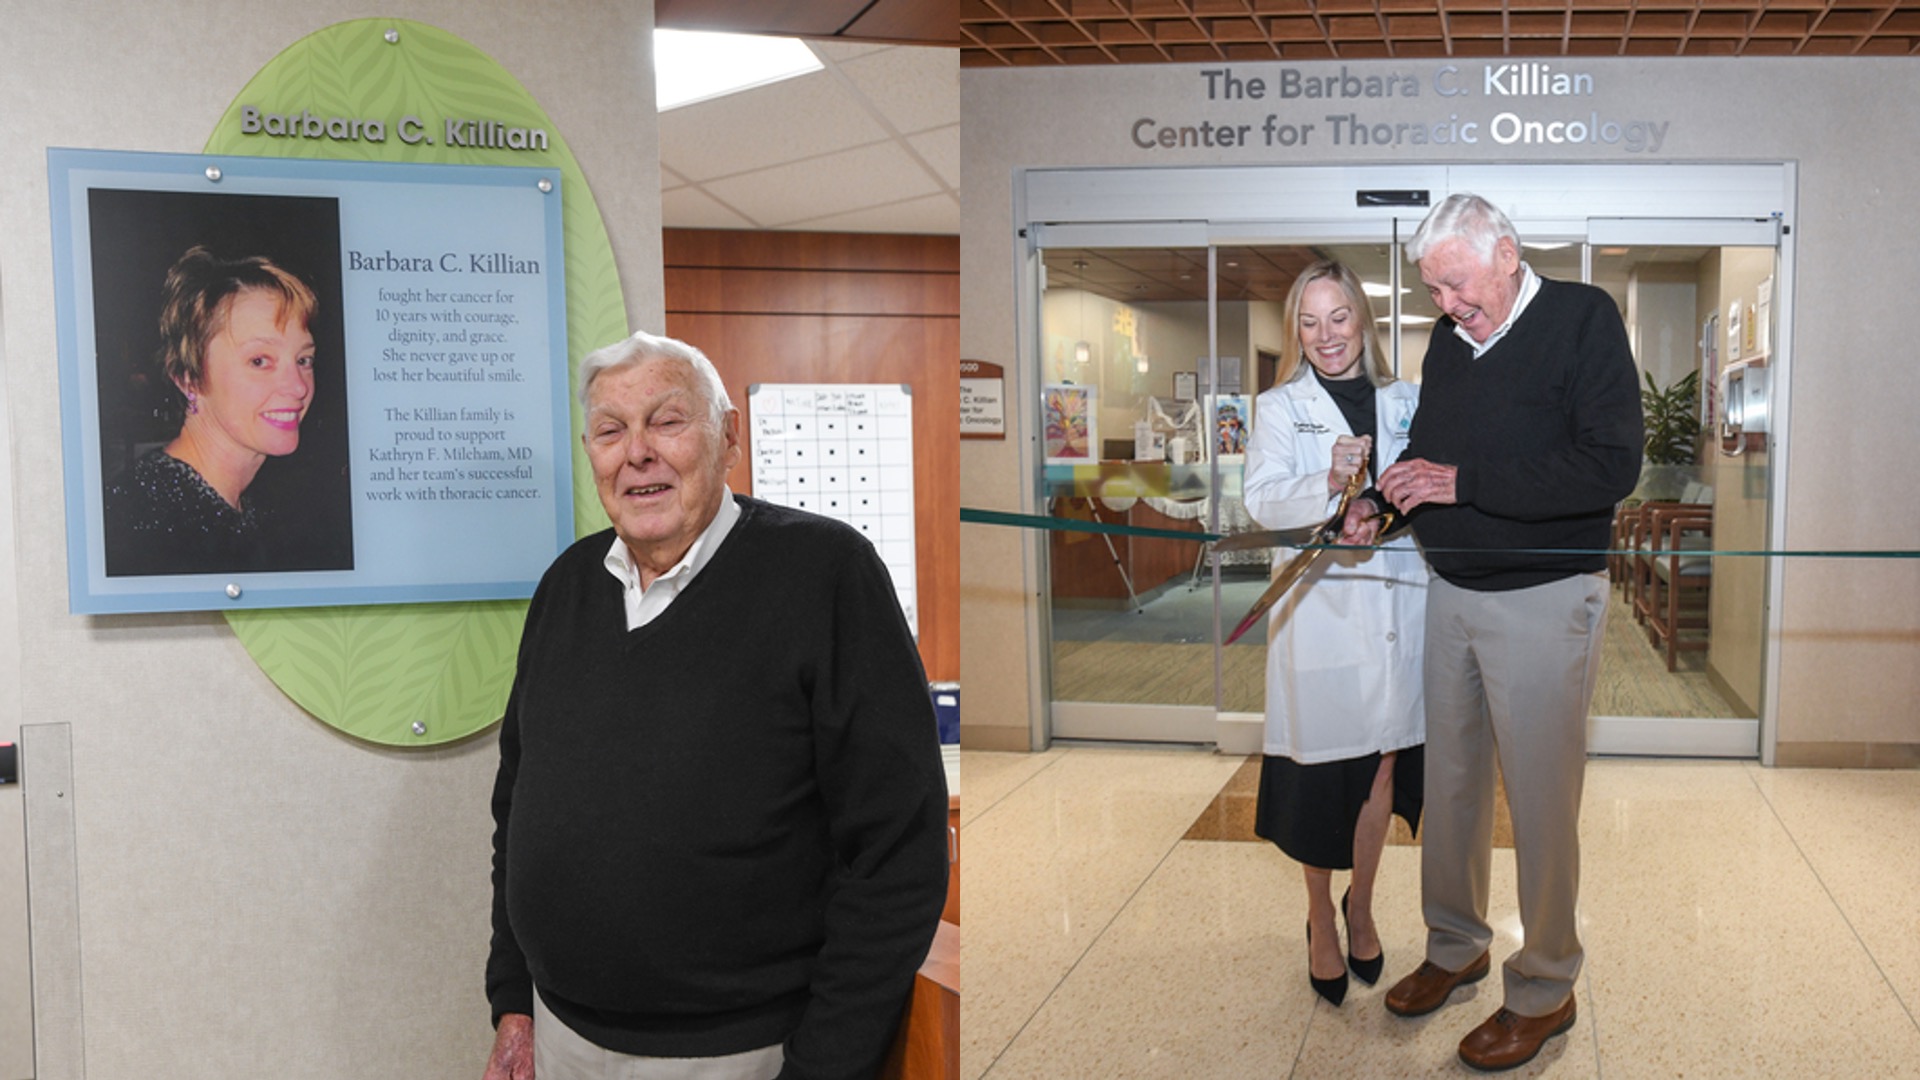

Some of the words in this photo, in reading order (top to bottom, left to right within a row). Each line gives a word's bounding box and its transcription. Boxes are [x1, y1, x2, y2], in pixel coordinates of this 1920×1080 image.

[1201, 69, 1266, 99] The
[1280, 67, 1420, 99] Barbara
[1433, 66, 1468, 96] C.
[1484, 62, 1592, 95] Killian
[241, 105, 385, 142] Barbara
[398, 116, 434, 144] C.
[445, 118, 548, 150] Killian
[1131, 118, 1250, 149] Center
[1263, 114, 1313, 146] for
[1326, 113, 1478, 146] Thoracic
[1490, 112, 1669, 152] Oncology
[349, 251, 434, 272] Barbara
[440, 253, 462, 272] C.
[470, 253, 540, 274] Killian
[379, 288, 421, 306] fought
[426, 289, 446, 302] her
[450, 292, 493, 303] cancer
[496, 289, 514, 303] for
[376, 309, 389, 321] 10
[394, 312, 427, 325] years
[431, 310, 461, 322] with
[464, 312, 518, 325] courage,
[388, 328, 440, 345] dignity,
[443, 329, 467, 342] and
[470, 333, 507, 345] grace.
[383, 348, 408, 361] She
[410, 352, 445, 362] never
[449, 352, 477, 364] gave
[481, 353, 498, 364] up
[501, 353, 514, 362] or
[374, 368, 398, 381] lost
[402, 368, 423, 381] her
[426, 368, 484, 382] beautiful
[488, 369, 524, 382] smile.
[384, 408, 409, 421] The
[414, 408, 457, 421] Killian
[460, 408, 499, 424] family
[504, 408, 514, 421] is
[395, 427, 434, 444] proud
[438, 430, 452, 440] to
[455, 429, 505, 444] support
[369, 448, 423, 464] Kathryn
[428, 449, 439, 460] F.
[507, 447, 532, 460] MD
[370, 468, 394, 481] and
[398, 467, 419, 480] her
[468, 466, 532, 479] successful
[366, 487, 402, 501] work
[405, 487, 436, 500] with
[440, 486, 492, 499] thoracic
[496, 488, 541, 499] cancer.
